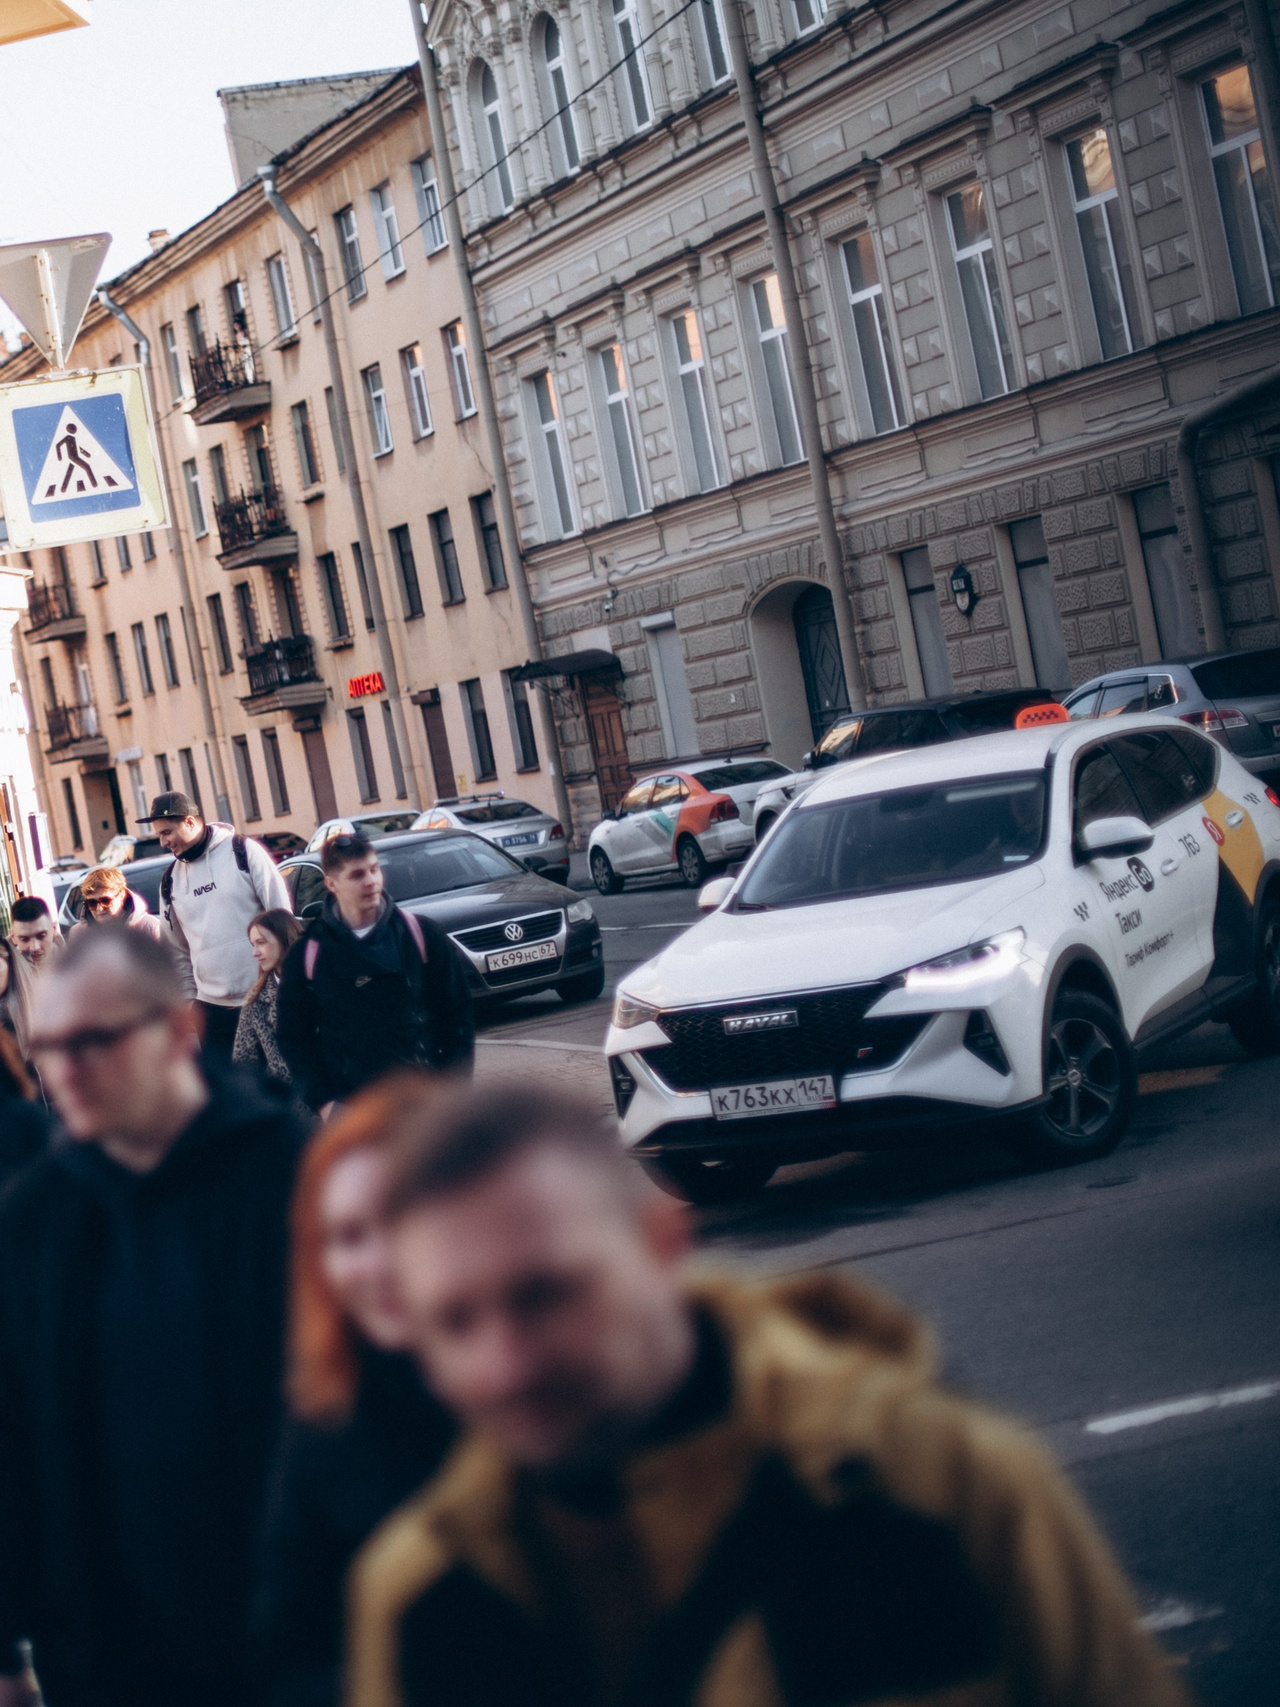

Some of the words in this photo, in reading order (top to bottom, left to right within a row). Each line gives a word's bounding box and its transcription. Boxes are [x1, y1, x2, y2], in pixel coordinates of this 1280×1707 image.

[348, 671, 384, 699] АПТЕКА
[1207, 822, 1222, 842] Я
[1178, 833, 1201, 857] 763
[193, 882, 217, 897] NASA
[1099, 872, 1139, 903] Яндекс
[1132, 864, 1153, 885] Go
[1115, 909, 1143, 935] Такси
[540, 944, 551, 955] 67
[1125, 946, 1145, 968] Тариф
[728, 1014, 793, 1032] HAVAL
[717, 1086, 796, 1111] К763КХ
[798, 1078, 827, 1097] 147
